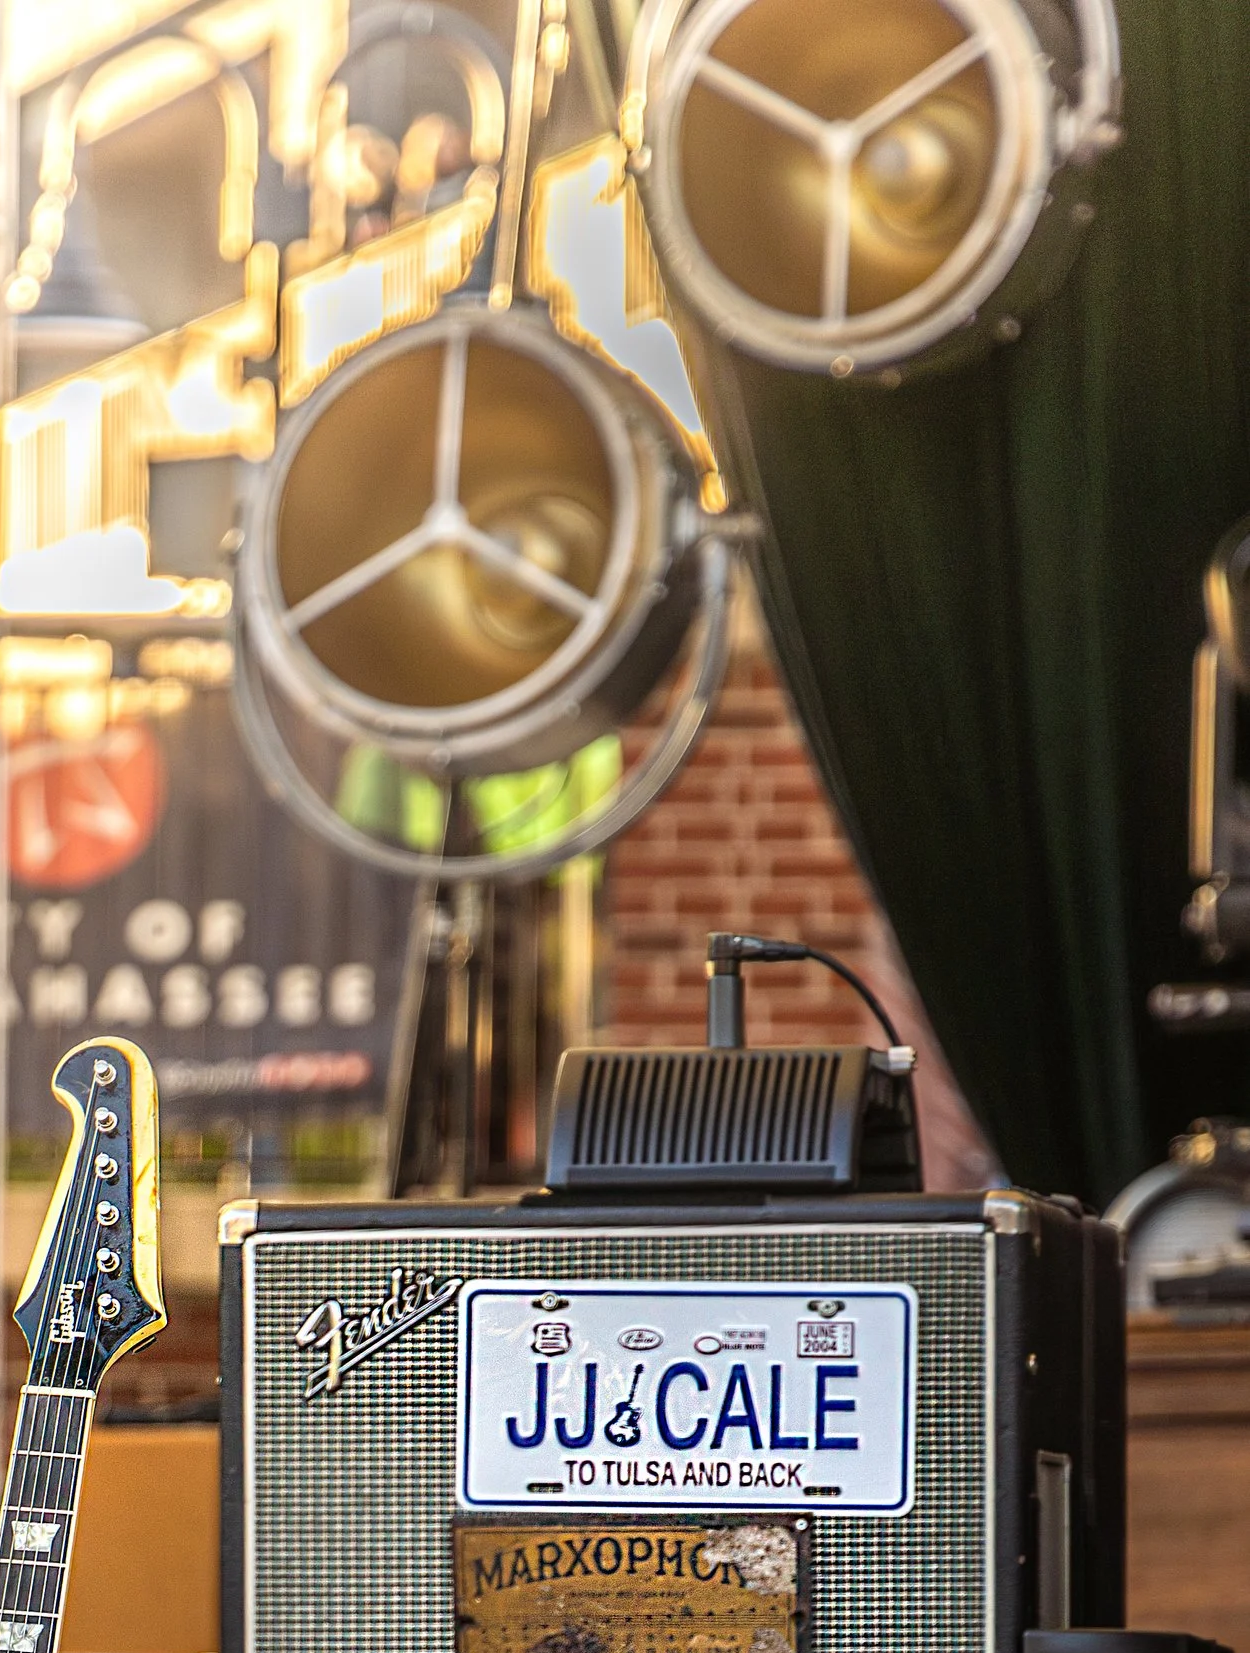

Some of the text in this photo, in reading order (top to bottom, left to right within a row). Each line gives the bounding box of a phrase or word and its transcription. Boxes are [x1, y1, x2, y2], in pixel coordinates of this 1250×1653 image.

[125, 899, 245, 962] OF
[295, 1267, 464, 1400] Fender
[803, 1325, 838, 1339] JUNE
[803, 1340, 838, 1352] 2004
[655, 1361, 859, 1450] CALE
[565, 1461, 803, 1489] TO TULSA AND BACK
